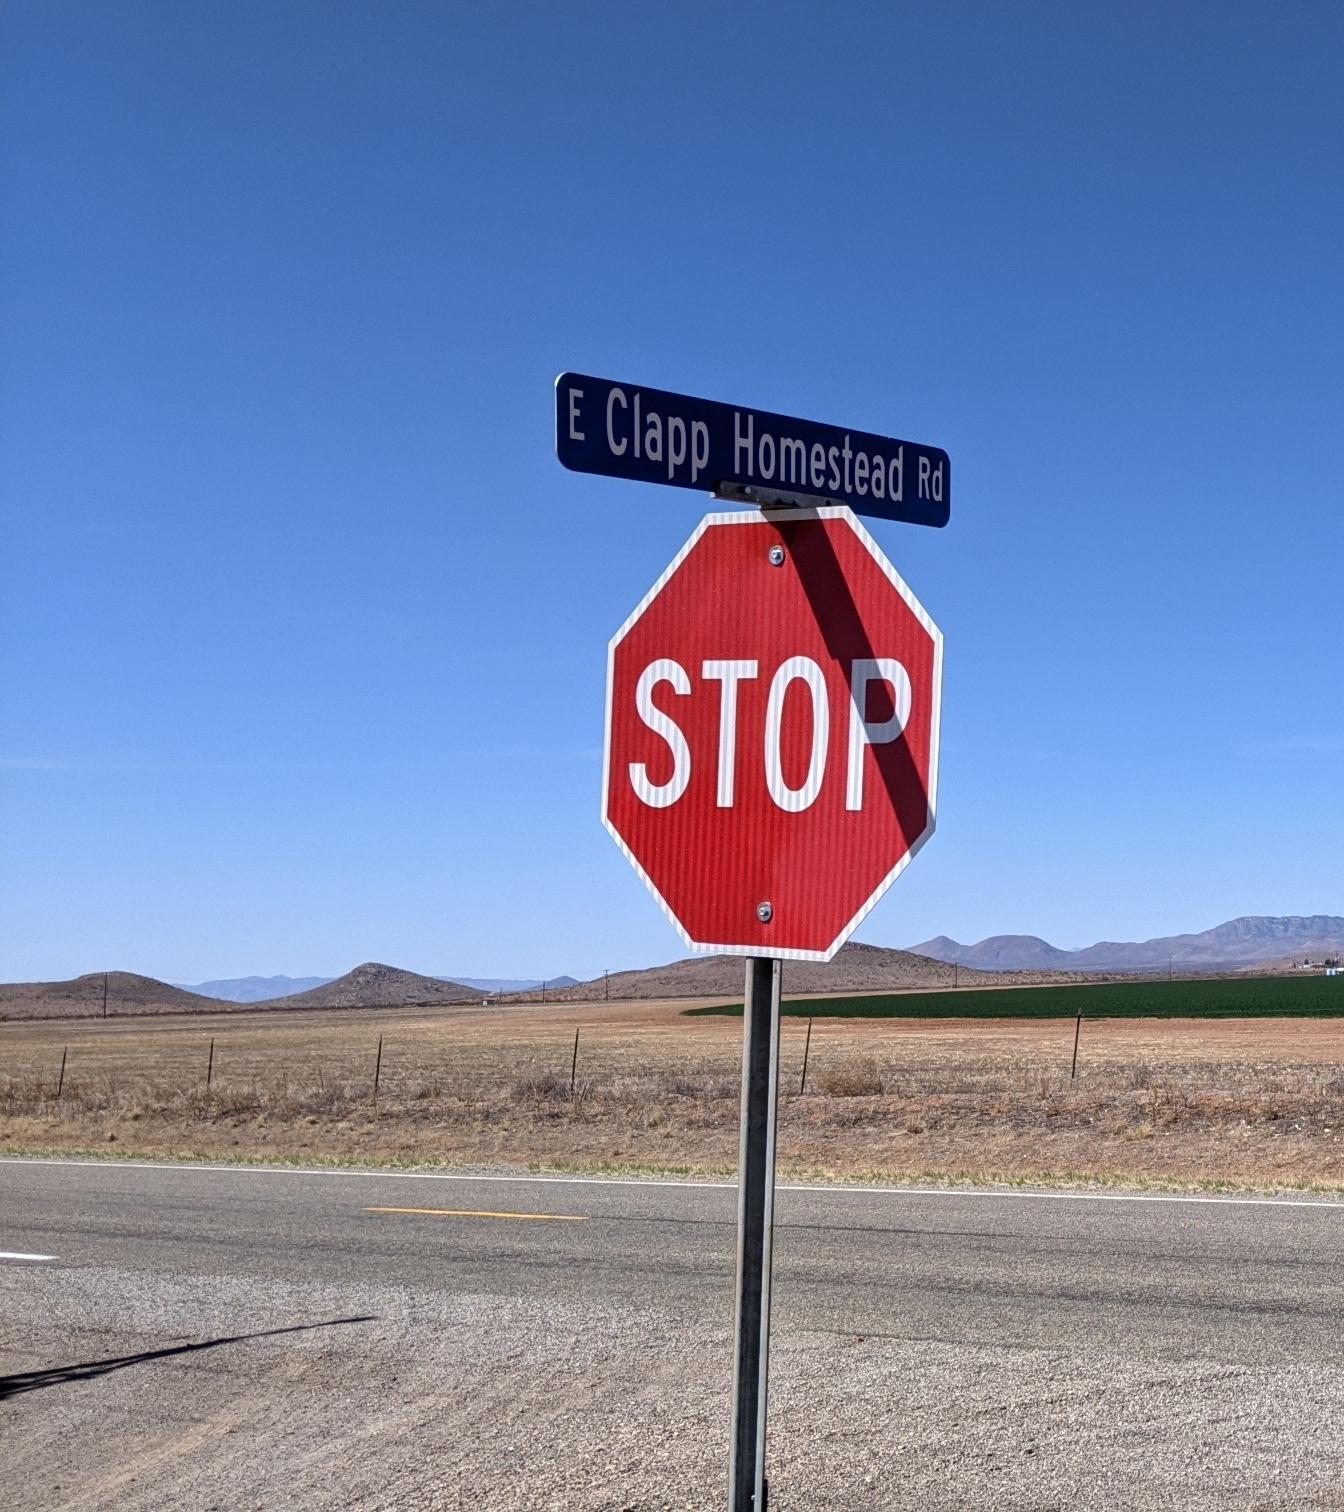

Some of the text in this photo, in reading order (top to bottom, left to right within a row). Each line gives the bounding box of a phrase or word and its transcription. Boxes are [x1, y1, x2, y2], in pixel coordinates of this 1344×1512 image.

[568, 387, 943, 502] E Clapp Homestead Rd
[628, 655, 912, 813] STOP
